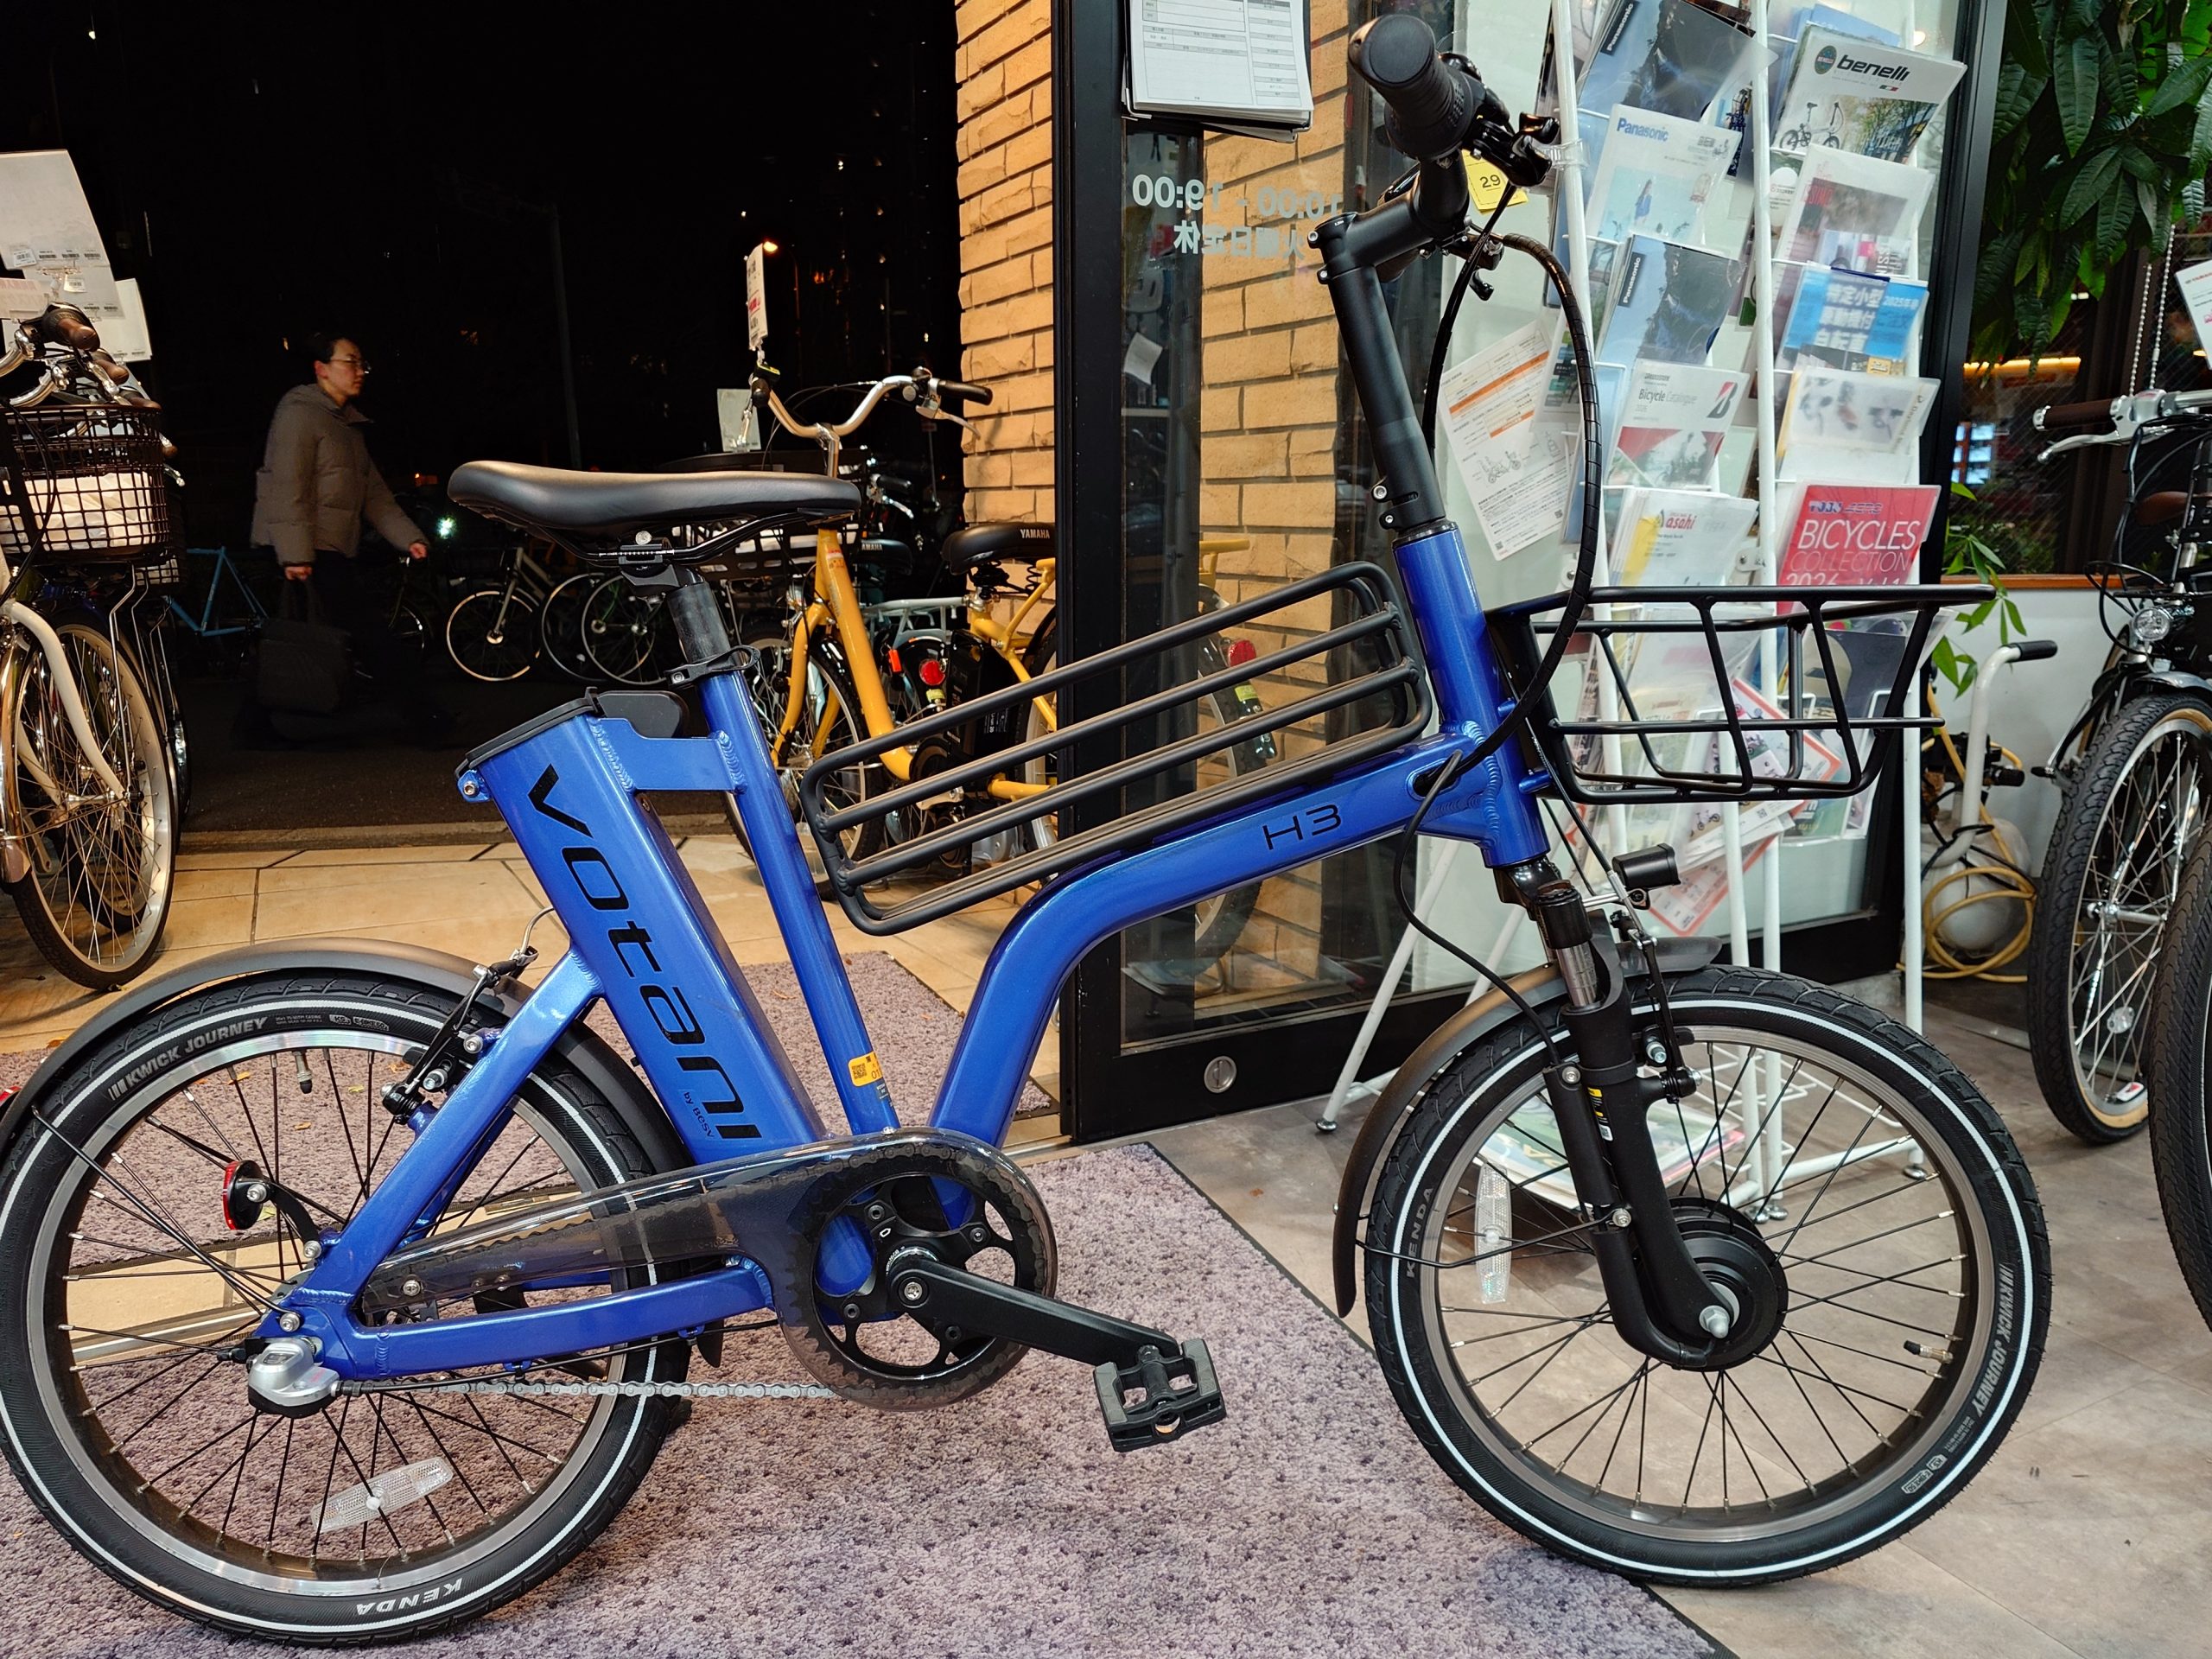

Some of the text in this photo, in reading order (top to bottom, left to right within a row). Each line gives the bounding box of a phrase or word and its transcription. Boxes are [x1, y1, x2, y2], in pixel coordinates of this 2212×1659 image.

[1606, 3, 1634, 51] Panasonic
[1836, 54, 1910, 82] benelli
[1617, 118, 1669, 142] Panasonic
[1479, 174, 1501, 188] 29
[1623, 257, 1642, 303] Panasonic
[1638, 388, 1667, 404] Bicycle
[1020, 529, 1051, 539] YAMAHA
[1665, 514, 1697, 530] asahi
[1797, 519, 1921, 550] BICYCLES
[861, 543, 883, 551] AMAHA
[1790, 551, 1910, 572] COLLECTION
[1262, 804, 1342, 850] H3
[126, 1017, 268, 1088] KWICK JOURNEY
[683, 1091, 694, 1106] by
[1406, 1188, 1434, 1278] KENDA
[1971, 1283, 2015, 1418] KWICK JOURNEY
[356, 1578, 463, 1615] KENDA
